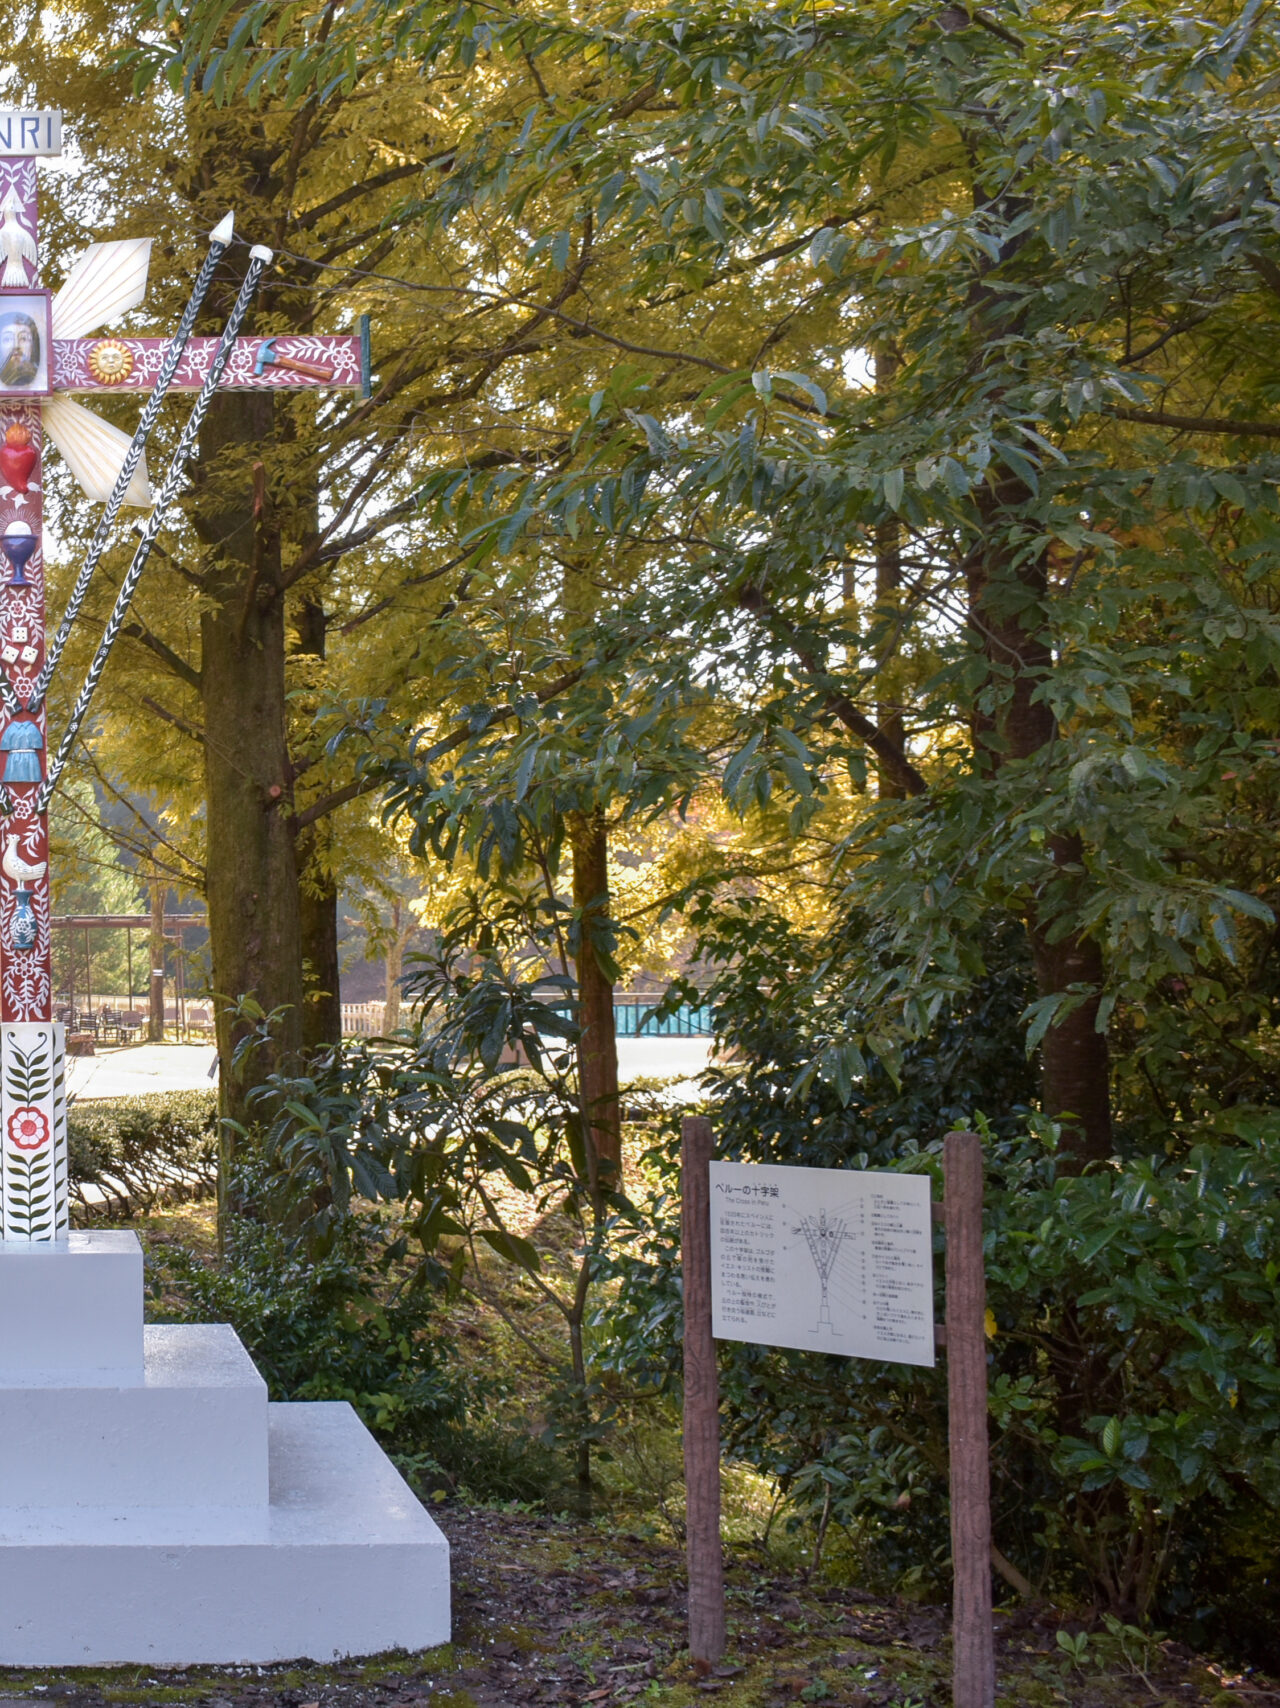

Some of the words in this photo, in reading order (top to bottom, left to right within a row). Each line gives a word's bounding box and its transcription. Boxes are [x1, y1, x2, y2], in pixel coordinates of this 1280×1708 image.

[715, 1184, 780, 1198] ペルーの十字架
